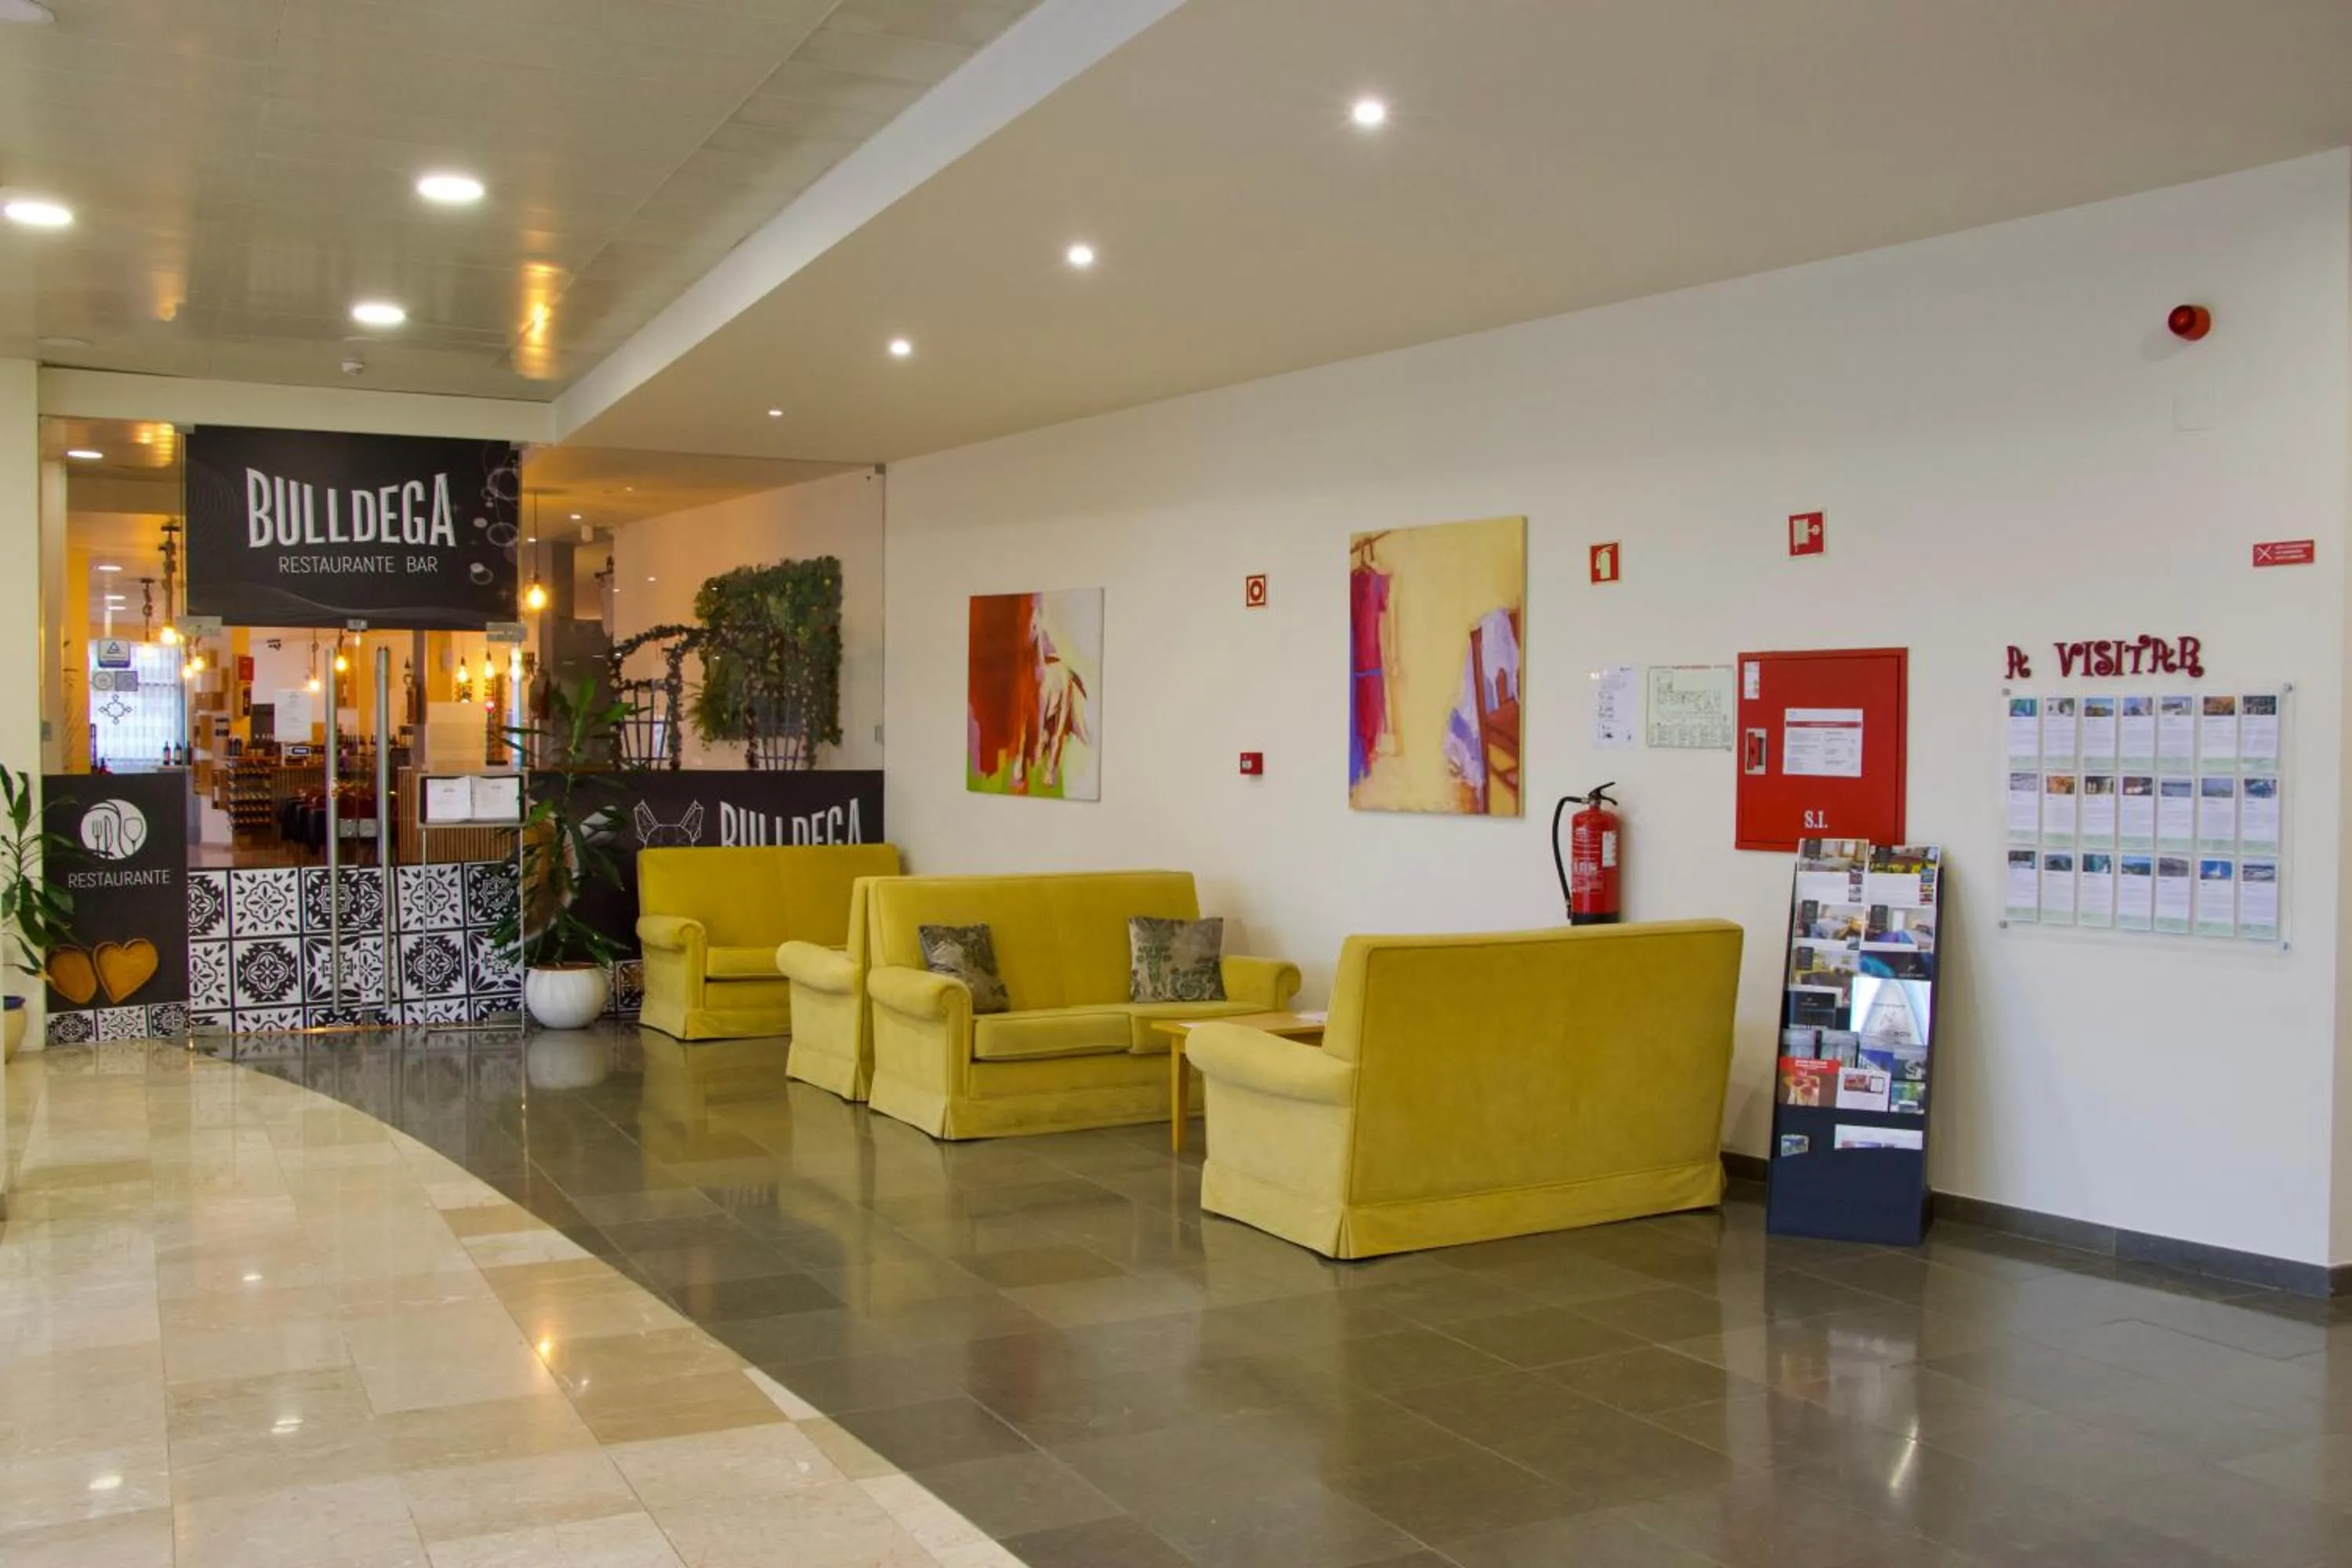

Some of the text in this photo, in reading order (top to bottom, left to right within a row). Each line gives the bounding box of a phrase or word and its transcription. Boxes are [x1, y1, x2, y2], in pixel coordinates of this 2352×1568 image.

[245, 467, 456, 548] BULLDEGA
[279, 556, 438, 573] RESTAURANTE BAR
[2005, 634, 2205, 680] A VISITAR
[68, 869, 171, 888] RESTAURANTE
